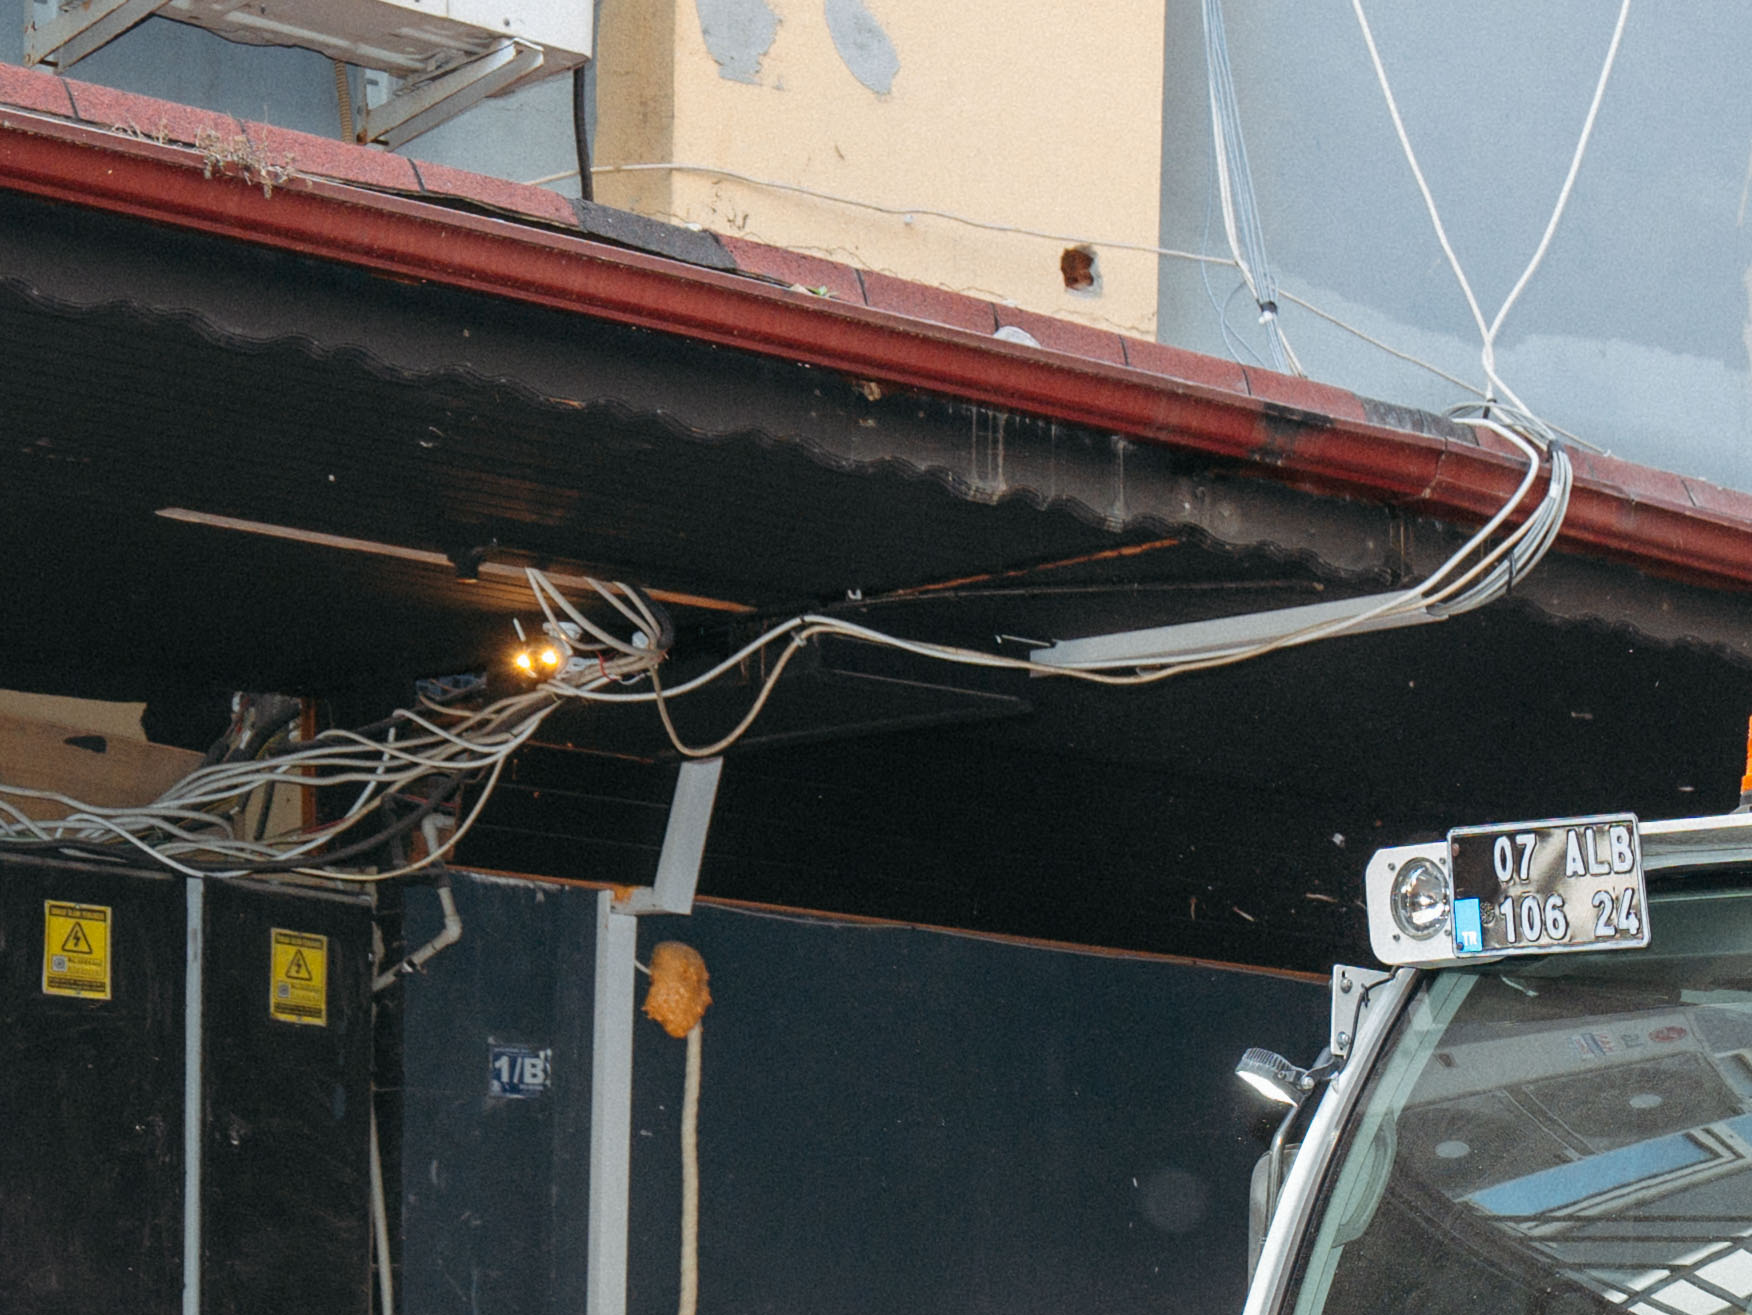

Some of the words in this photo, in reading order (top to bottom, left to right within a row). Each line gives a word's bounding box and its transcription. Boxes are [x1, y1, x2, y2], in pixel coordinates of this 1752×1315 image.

[1493, 832, 1537, 883] 07
[1565, 824, 1634, 878] ALB
[1499, 892, 1570, 944] 106
[1591, 886, 1641, 938] 24
[1461, 930, 1478, 947] TR
[494, 1055, 546, 1085] 1/B
